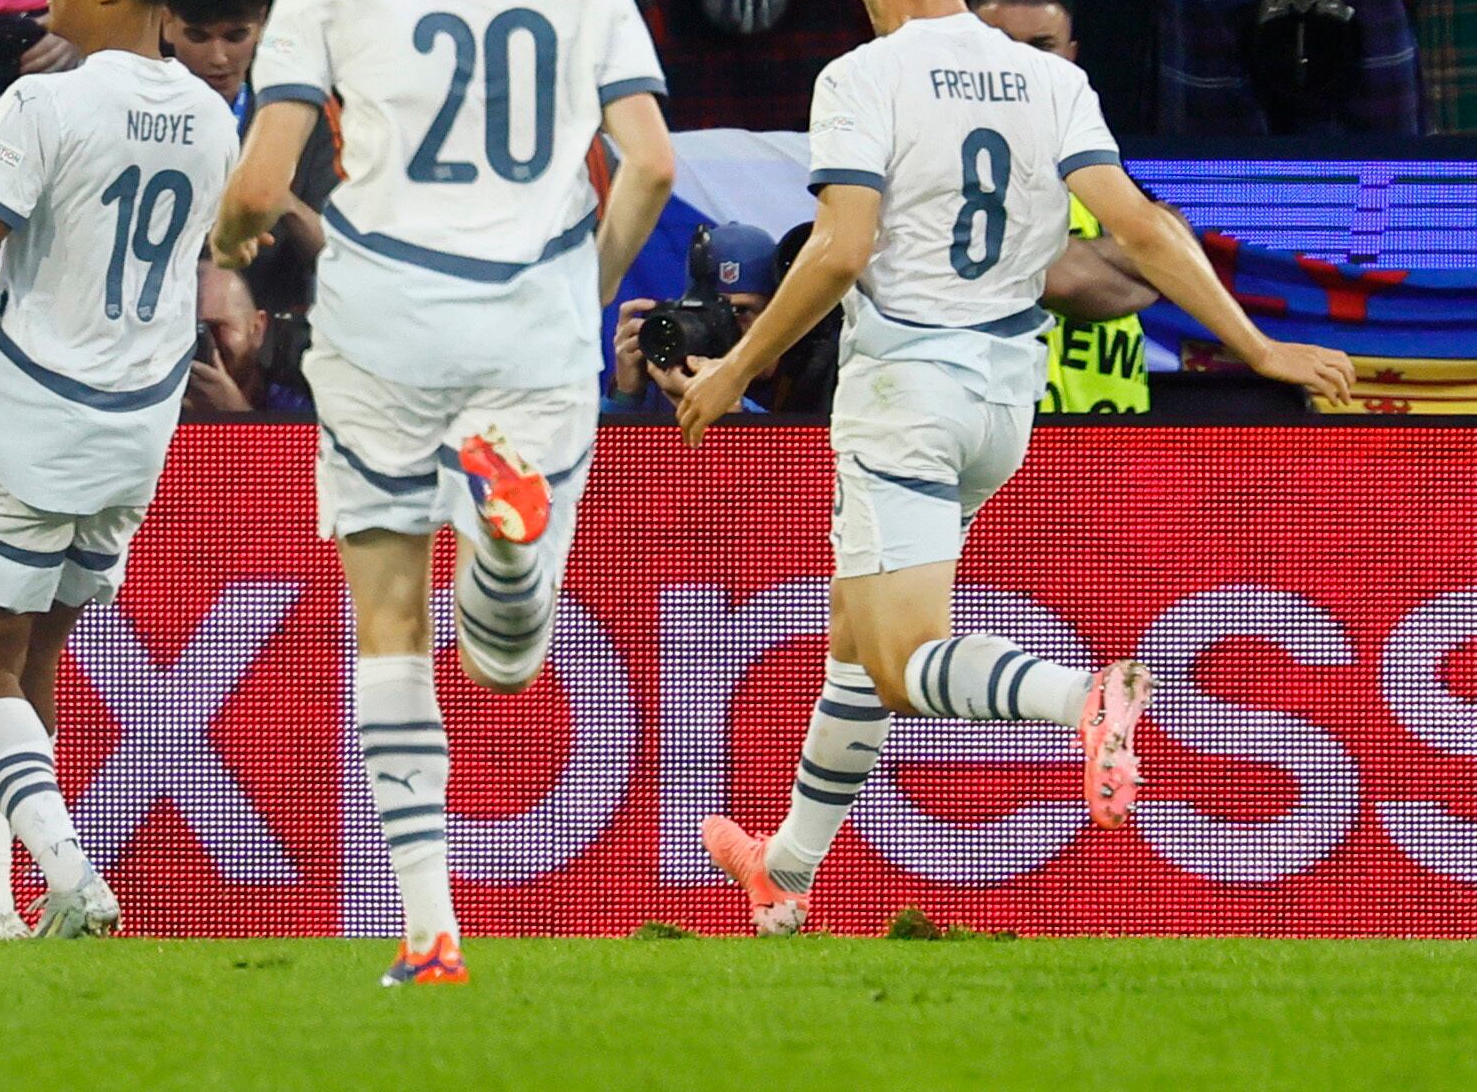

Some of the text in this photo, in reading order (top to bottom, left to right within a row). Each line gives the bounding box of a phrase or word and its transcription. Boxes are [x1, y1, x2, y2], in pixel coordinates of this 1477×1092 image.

[126, 110, 195, 145] NDOYE
[406, 7, 558, 184] 20
[930, 68, 1030, 103] FREULER
[101, 164, 193, 322] 19
[950, 127, 1011, 280] 8
